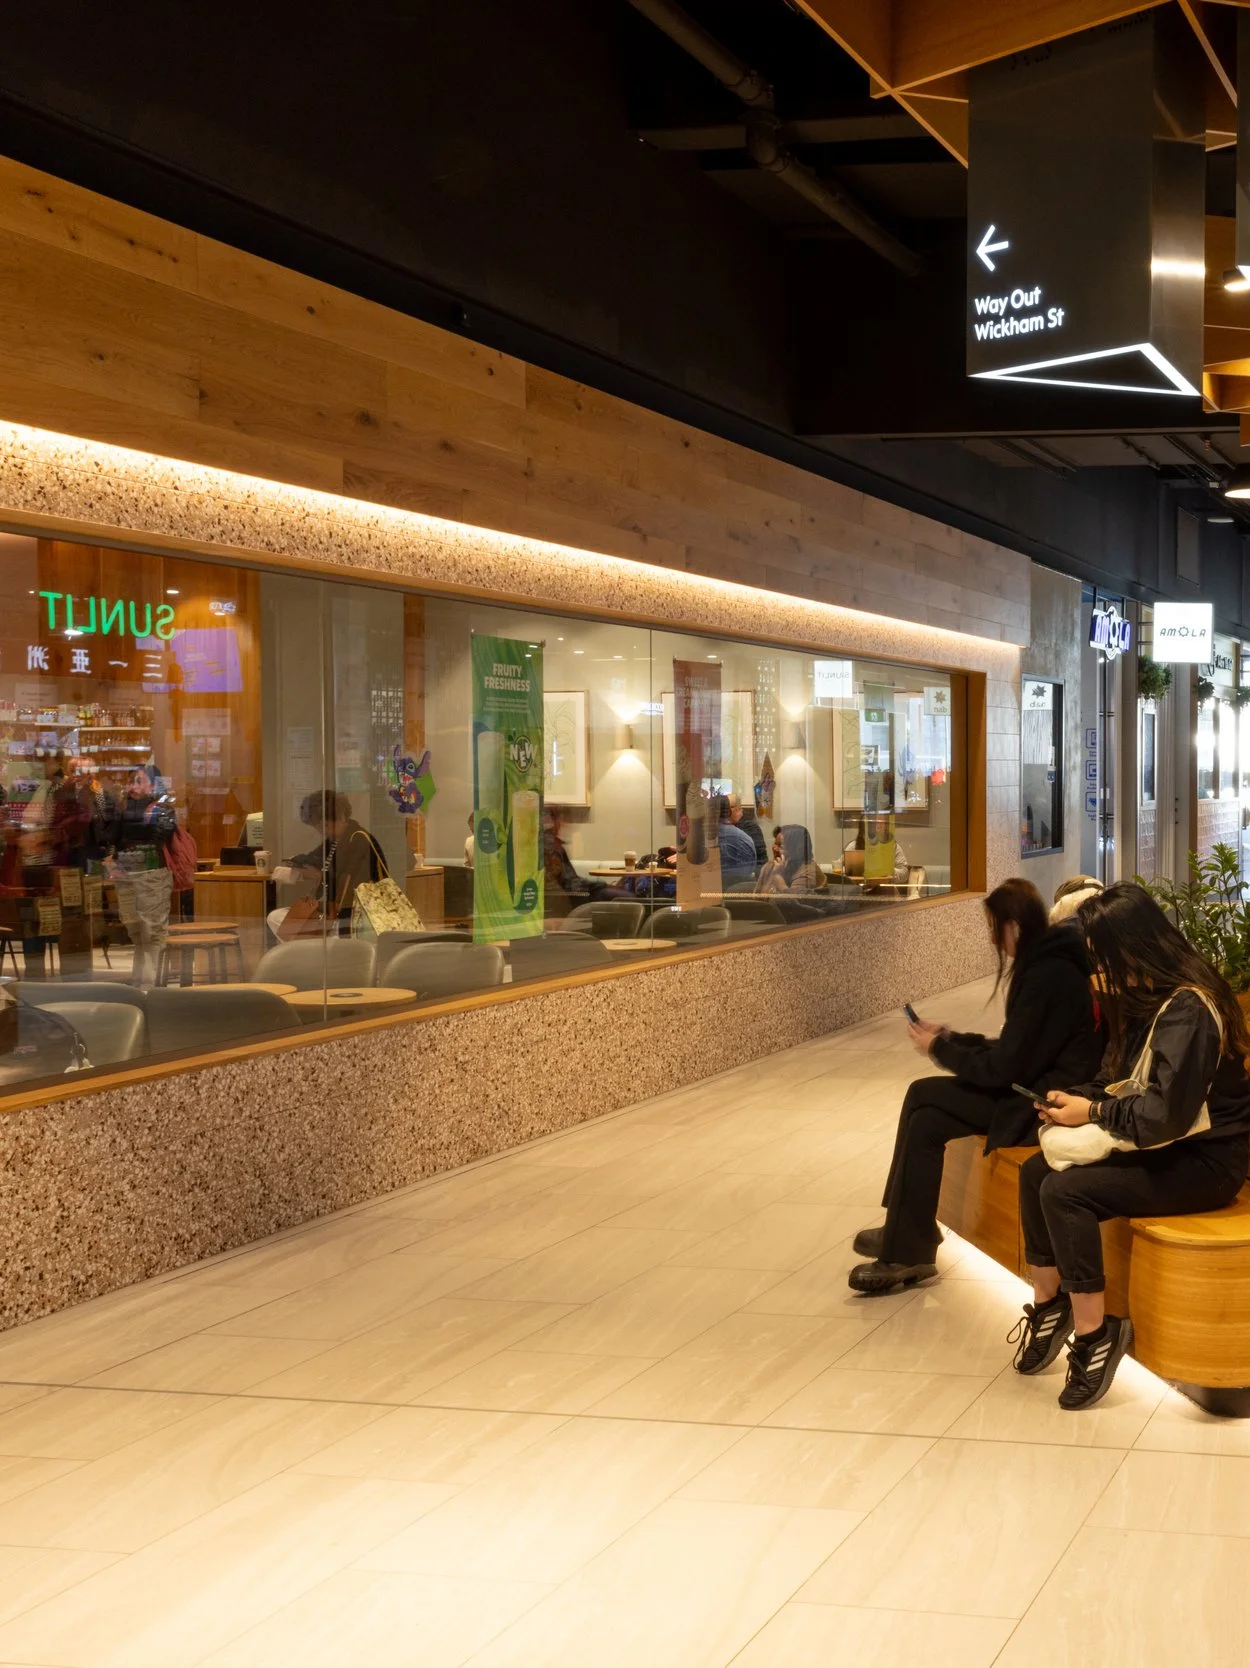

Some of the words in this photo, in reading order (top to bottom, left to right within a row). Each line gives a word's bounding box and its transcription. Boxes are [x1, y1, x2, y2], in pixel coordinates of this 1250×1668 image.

[974, 295, 1009, 316] Way
[1010, 286, 1042, 309] Out
[974, 315, 1044, 341] Wickham
[1047, 307, 1065, 328] St
[1159, 626, 1207, 638] AMOLA
[492, 663, 522, 679] FRUITY
[484, 676, 531, 693] FRESHNESS
